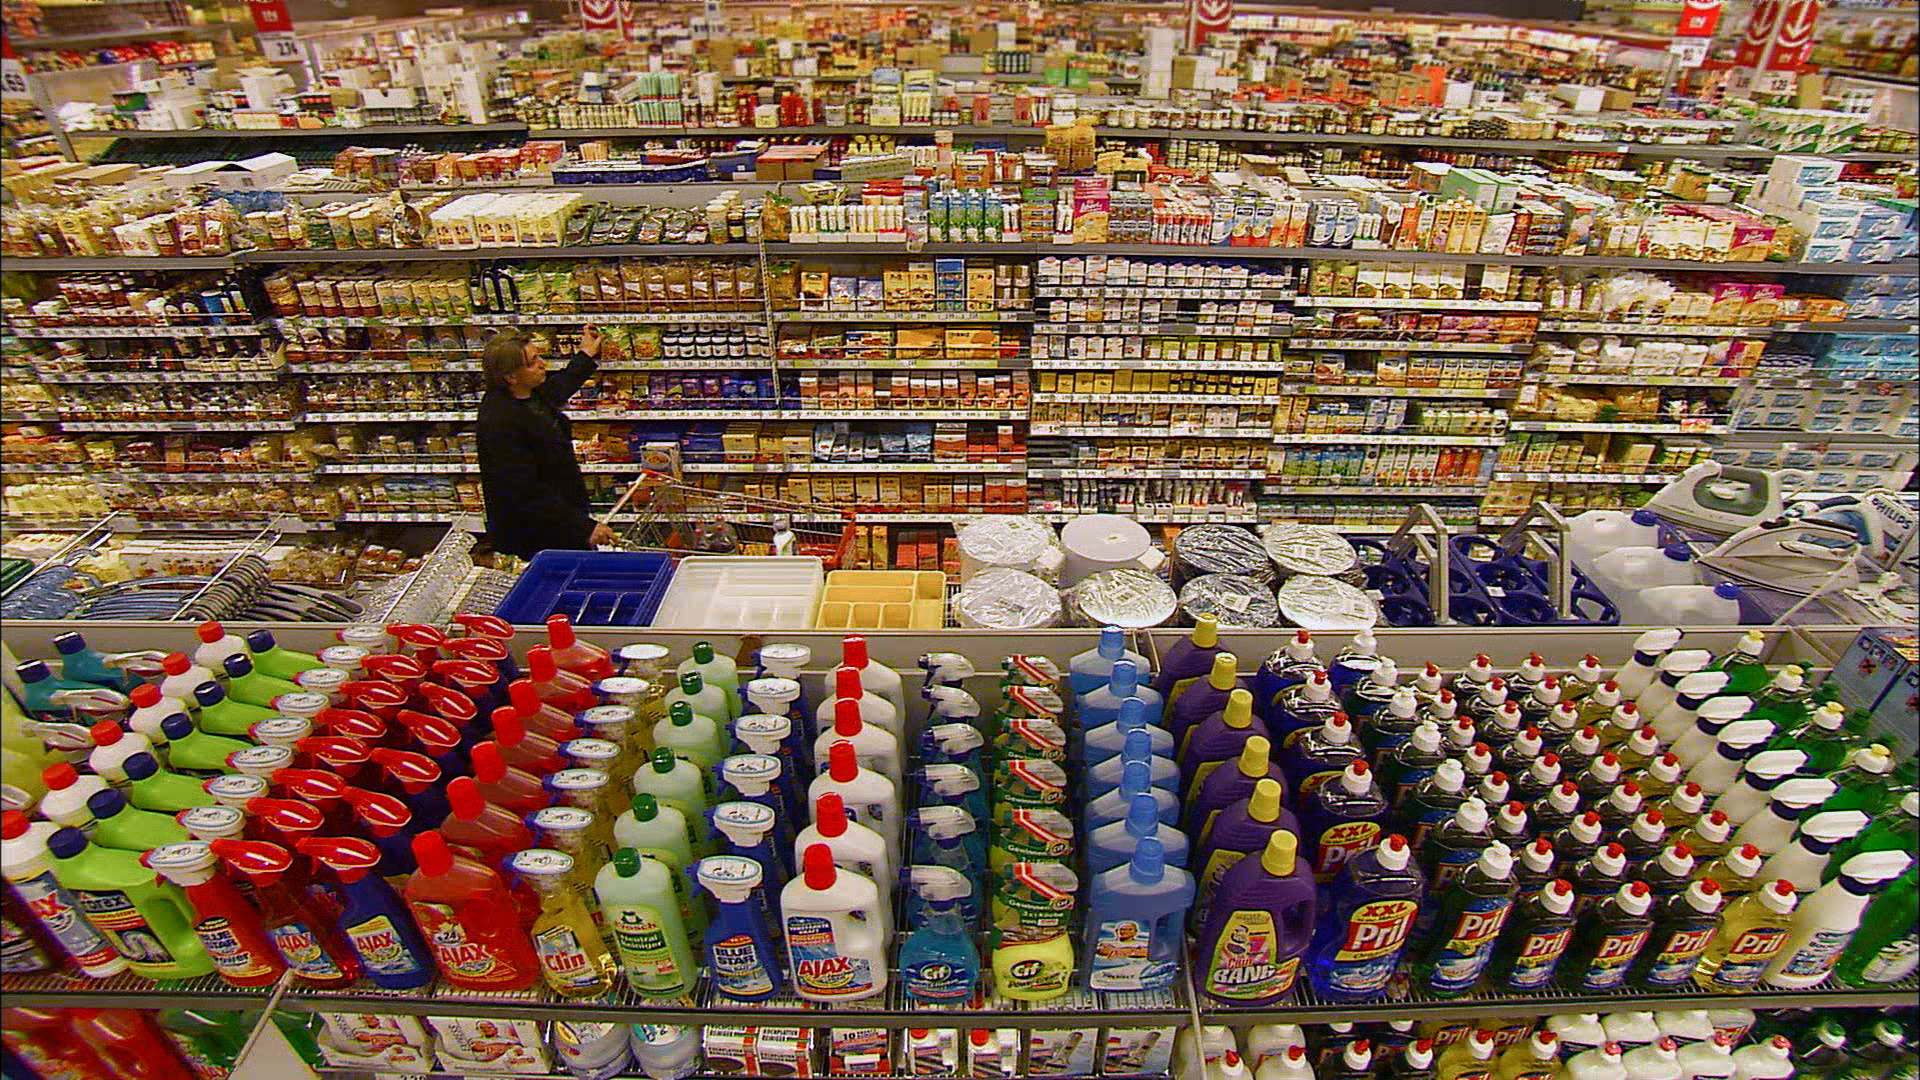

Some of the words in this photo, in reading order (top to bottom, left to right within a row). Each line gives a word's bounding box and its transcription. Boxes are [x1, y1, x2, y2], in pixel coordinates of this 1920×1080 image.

[1871, 497, 1913, 529] PHILIPS
[1329, 823, 1371, 839] XXL
[1362, 902, 1407, 917] XXL
[1351, 914, 1411, 950] Pril
[1458, 907, 1506, 938] Pril
[277, 931, 315, 951] AJAX
[357, 931, 396, 952] AJAX
[620, 933, 658, 943] Neutral
[621, 940, 662, 951] Reiniger
[1524, 931, 1568, 956] Pril
[1600, 933, 1644, 958] Pril
[1667, 929, 1708, 953] Pril
[1734, 933, 1783, 954] Pril
[440, 944, 492, 967] AJAX
[715, 945, 753, 956] BLUE
[717, 955, 756, 966] STAR
[544, 951, 586, 972] Clin
[799, 957, 852, 979] AJAX
[1012, 963, 1040, 978] Cif
[922, 966, 947, 980] Cif
[843, 1032, 856, 1041] 10
[1437, 1026, 1470, 1048] Pril
[1495, 1025, 1531, 1047] Pril
